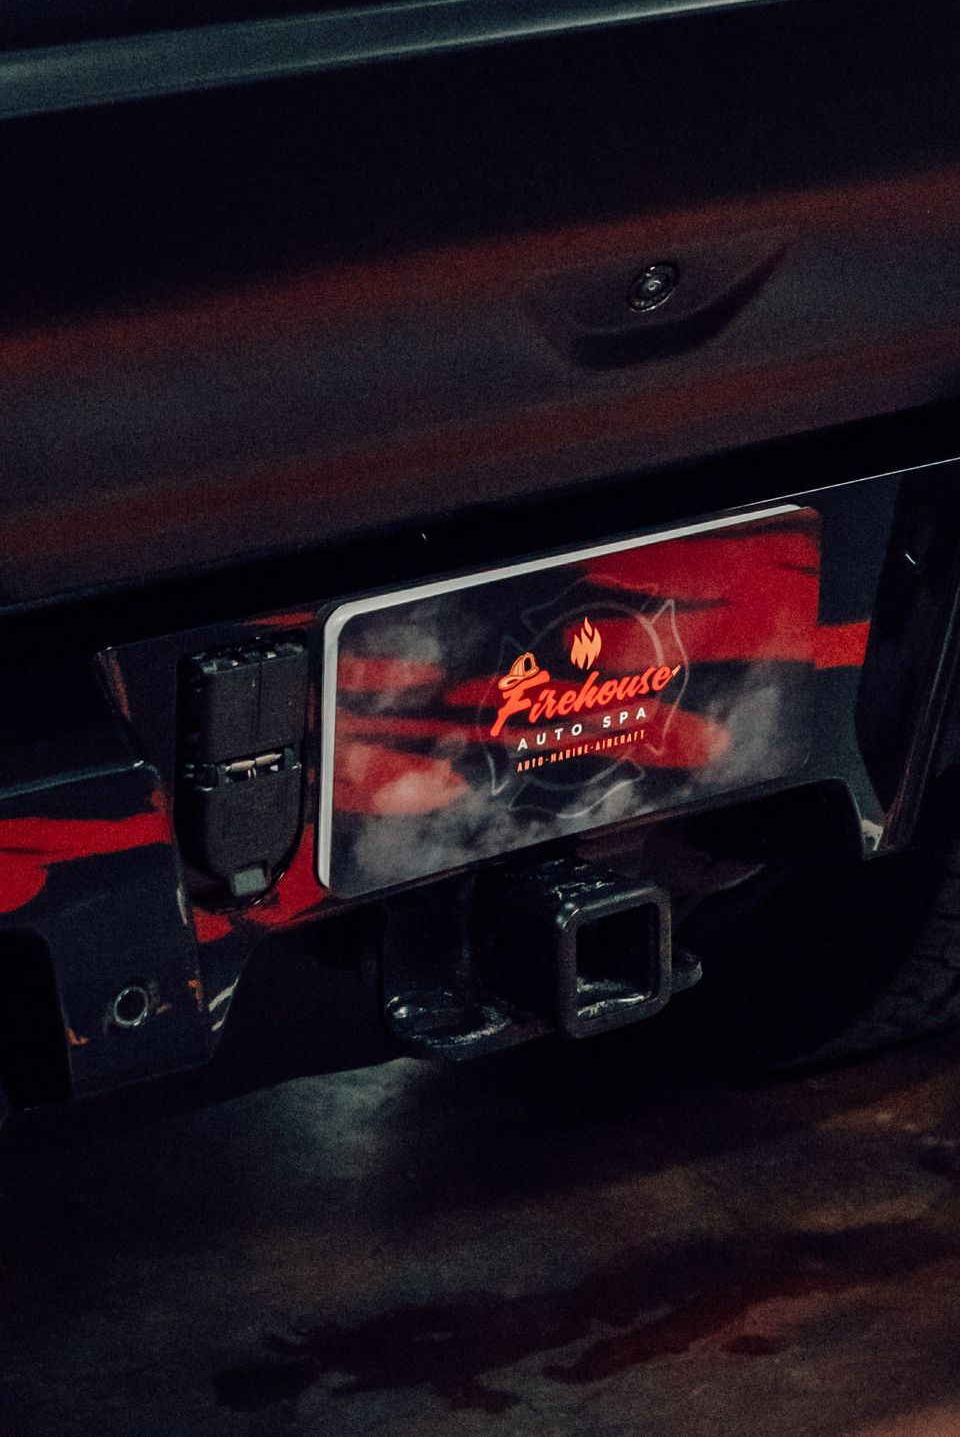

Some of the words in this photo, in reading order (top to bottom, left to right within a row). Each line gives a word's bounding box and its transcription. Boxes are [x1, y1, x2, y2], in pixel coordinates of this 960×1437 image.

[490, 665, 674, 737] Firehouse
[517, 723, 583, 752] AUTO
[602, 707, 647, 729] SPA
